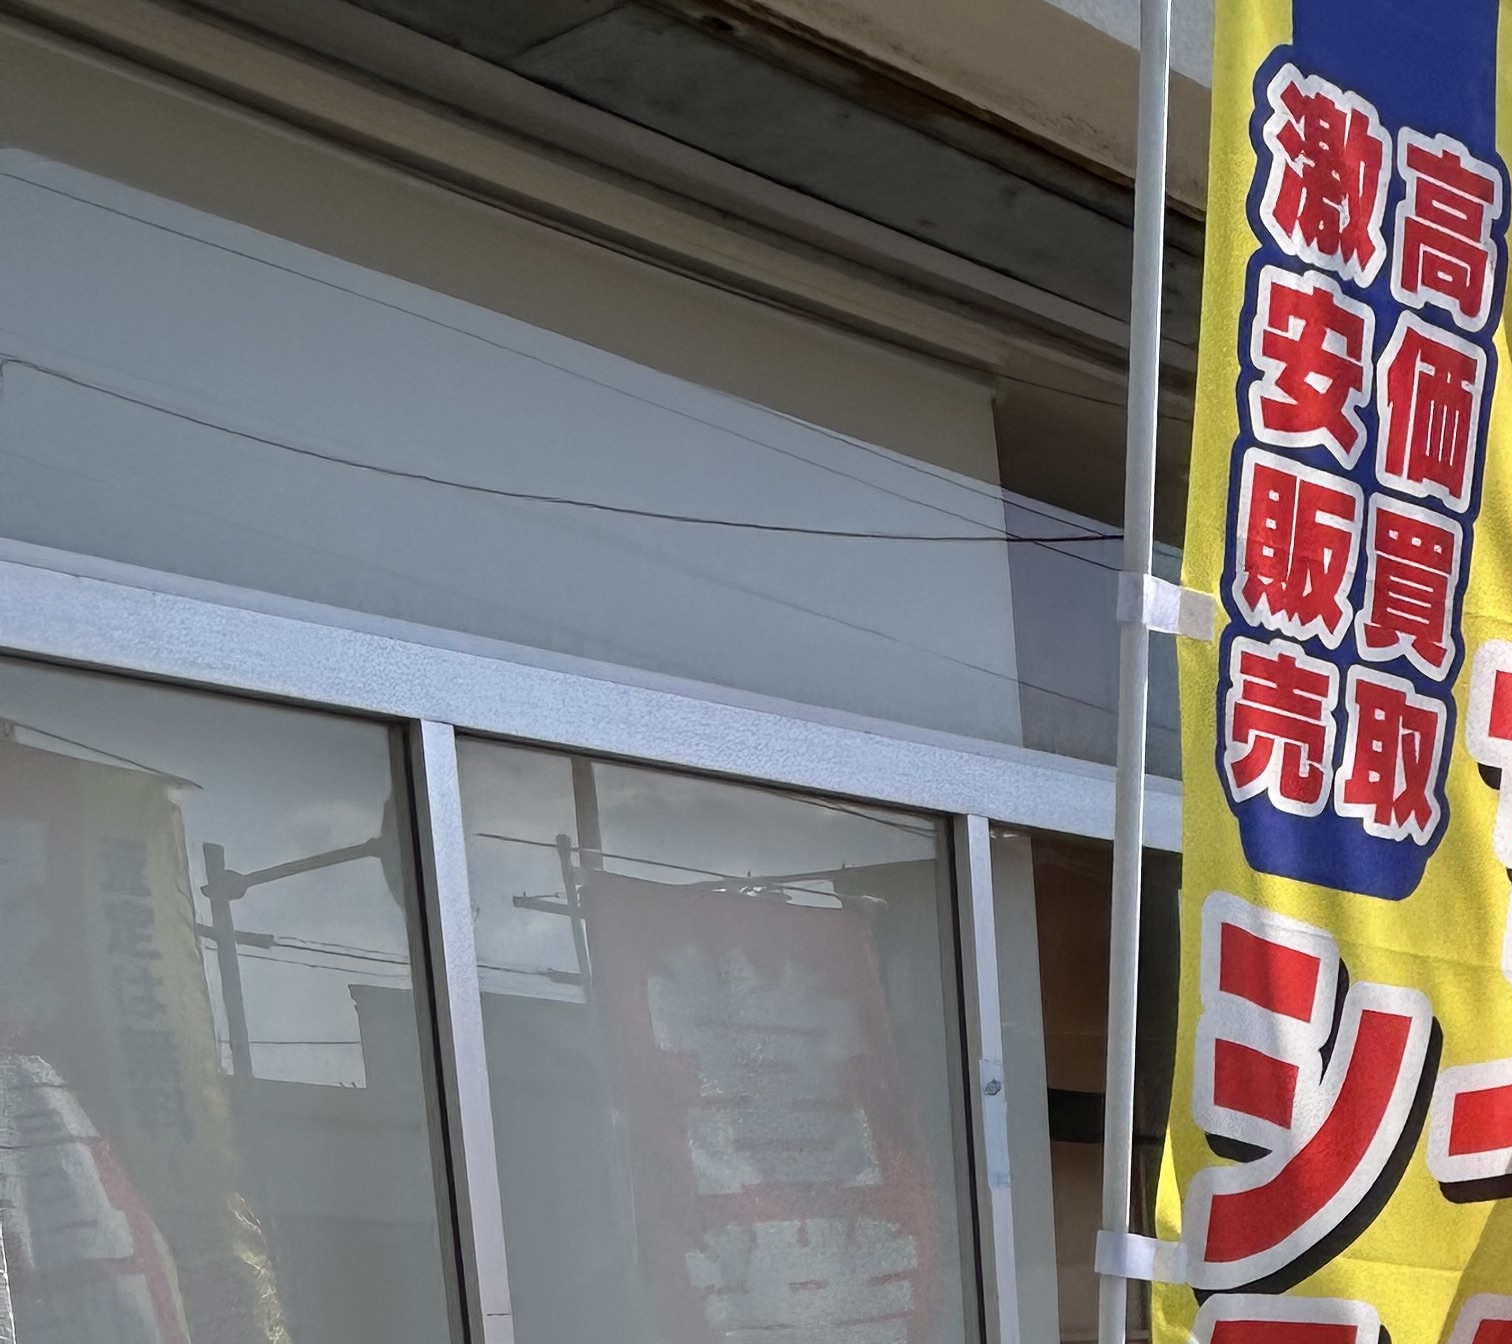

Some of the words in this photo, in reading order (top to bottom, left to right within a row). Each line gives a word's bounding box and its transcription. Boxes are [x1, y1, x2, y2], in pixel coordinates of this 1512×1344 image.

[1227, 64, 1391, 817] 激安販売
[1336, 127, 1504, 843] 高価買取
